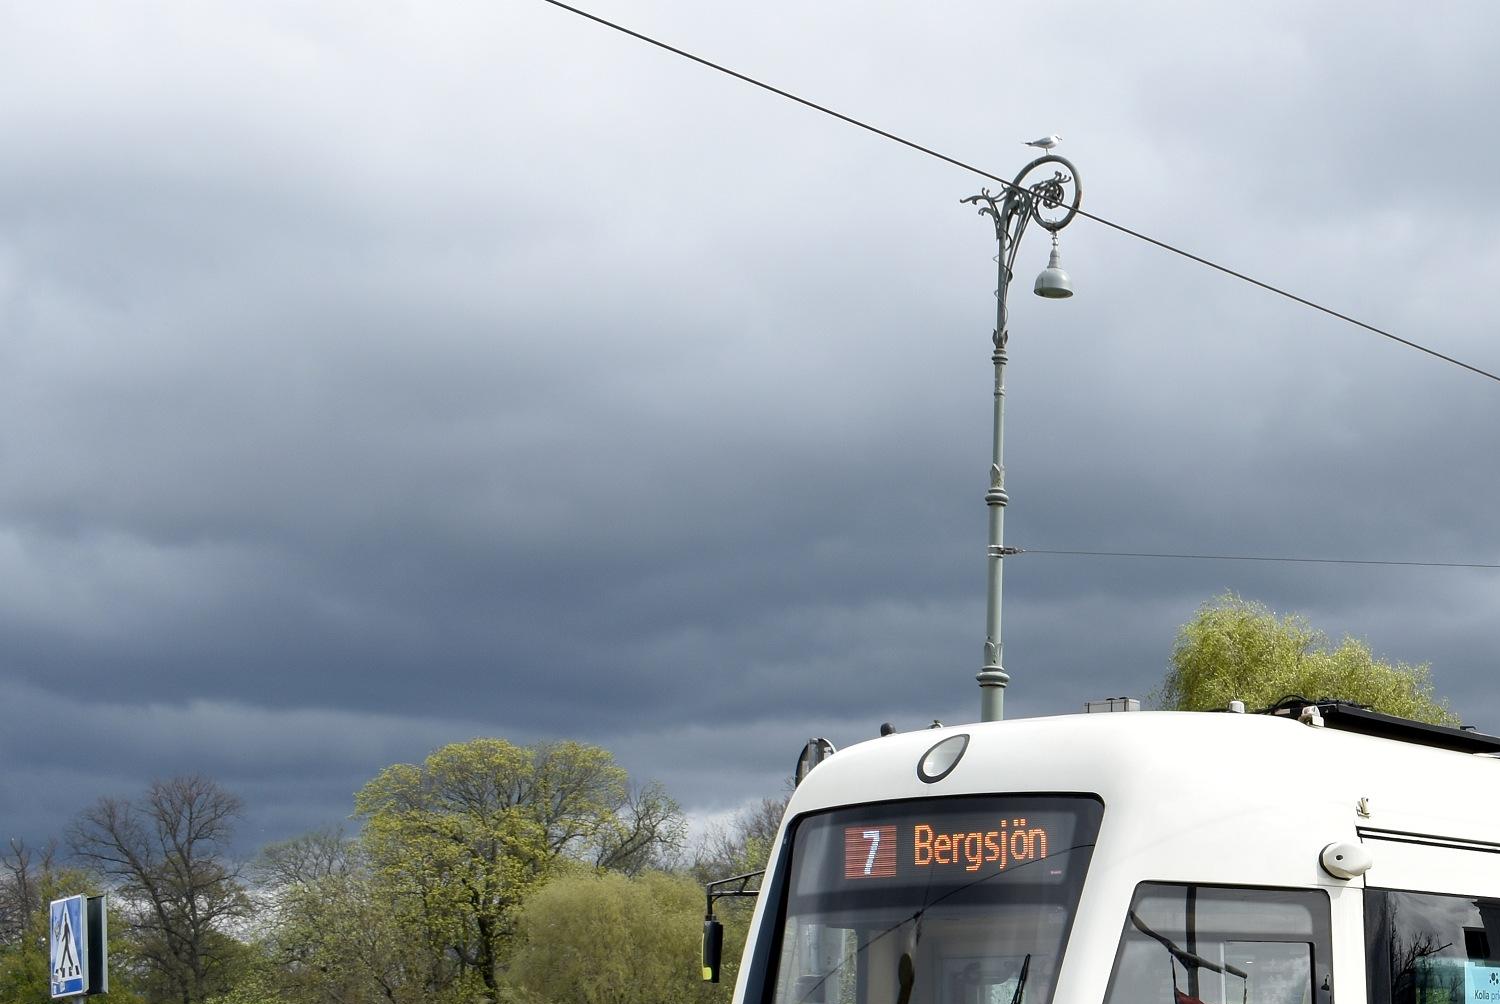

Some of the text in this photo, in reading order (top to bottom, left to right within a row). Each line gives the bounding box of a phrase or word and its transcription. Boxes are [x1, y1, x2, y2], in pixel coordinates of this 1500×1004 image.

[862, 818, 1047, 875] 7 Bergsjön
[1474, 989, 1490, 1000] Kolla
